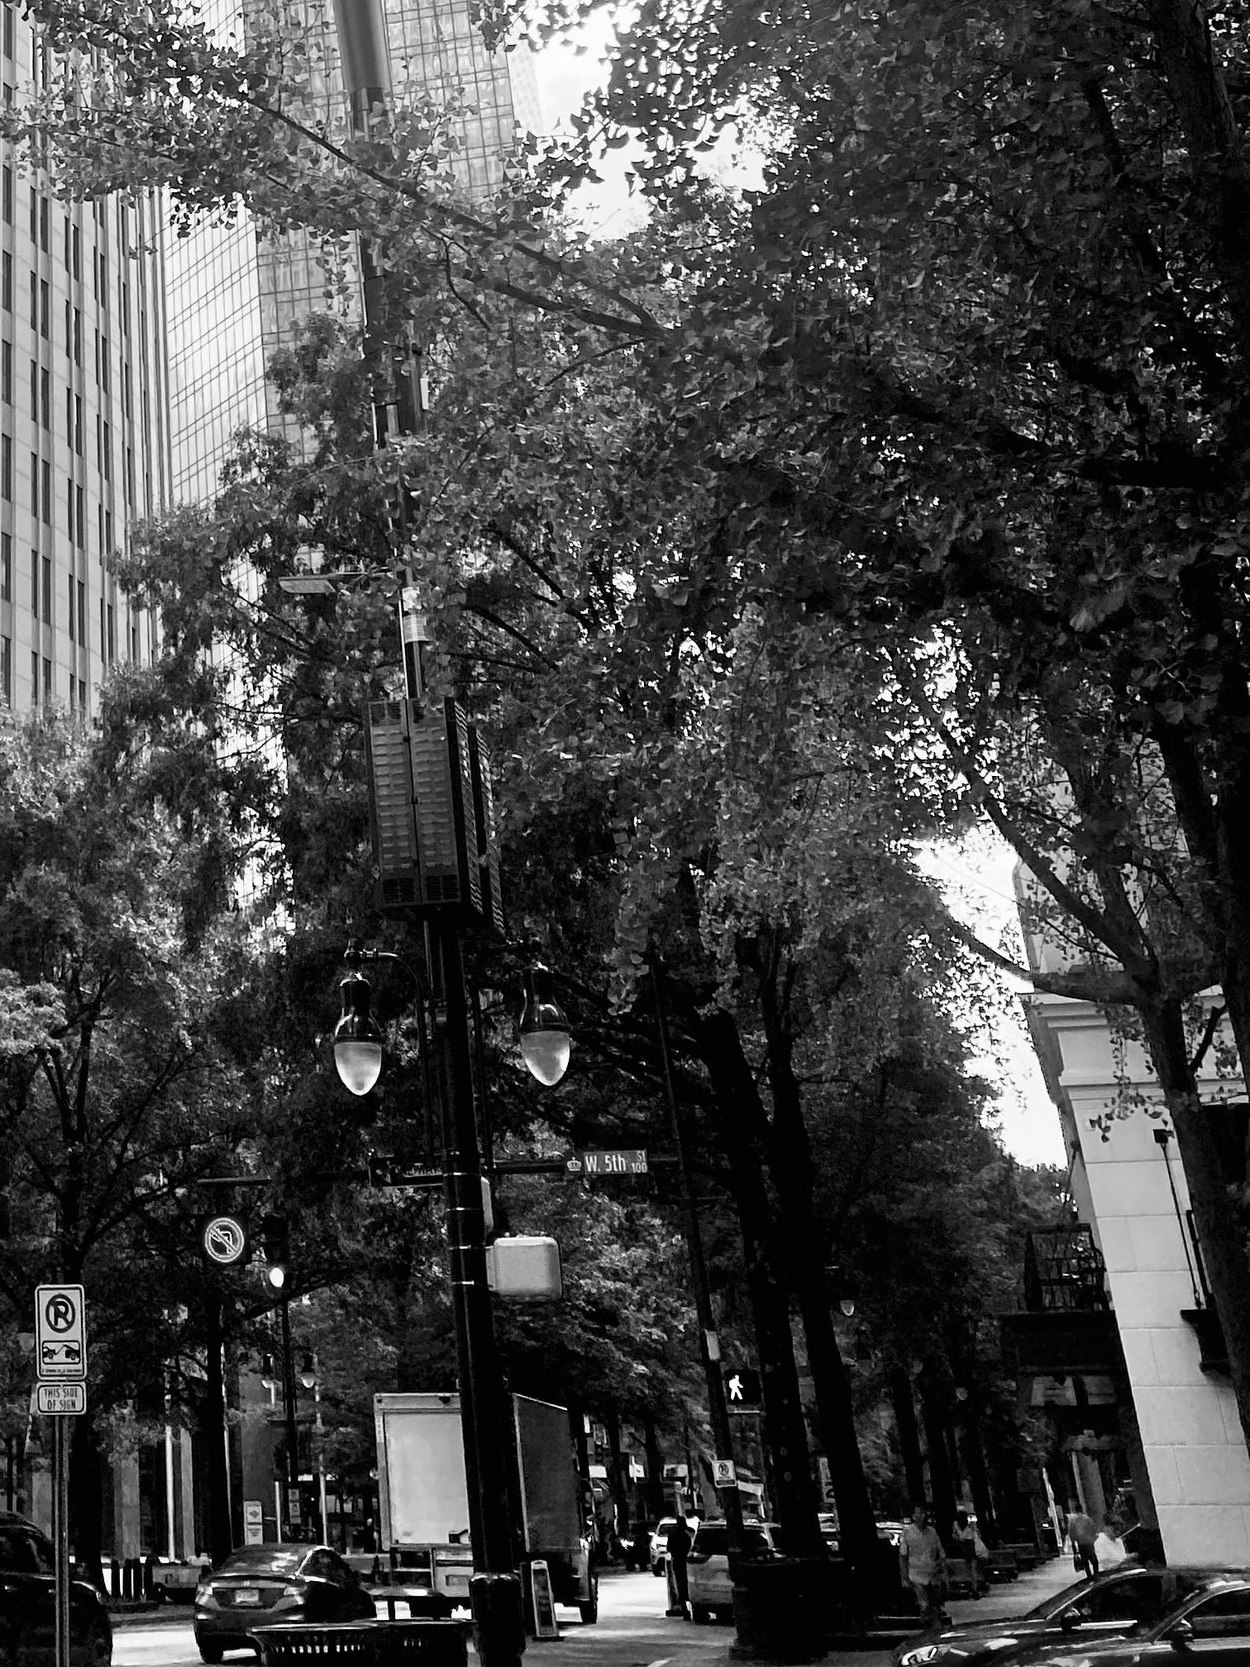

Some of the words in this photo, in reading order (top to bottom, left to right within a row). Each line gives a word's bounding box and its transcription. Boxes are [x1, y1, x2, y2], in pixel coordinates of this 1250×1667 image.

[585, 1155, 601, 1172] W.
[605, 1154, 626, 1172] 5th
[631, 1162, 647, 1173] 100
[44, 1388, 61, 1399] THIS
[62, 1387, 78, 1399] SIDE
[47, 1399, 56, 1410] OF
[60, 1399, 77, 1410] SIGN
